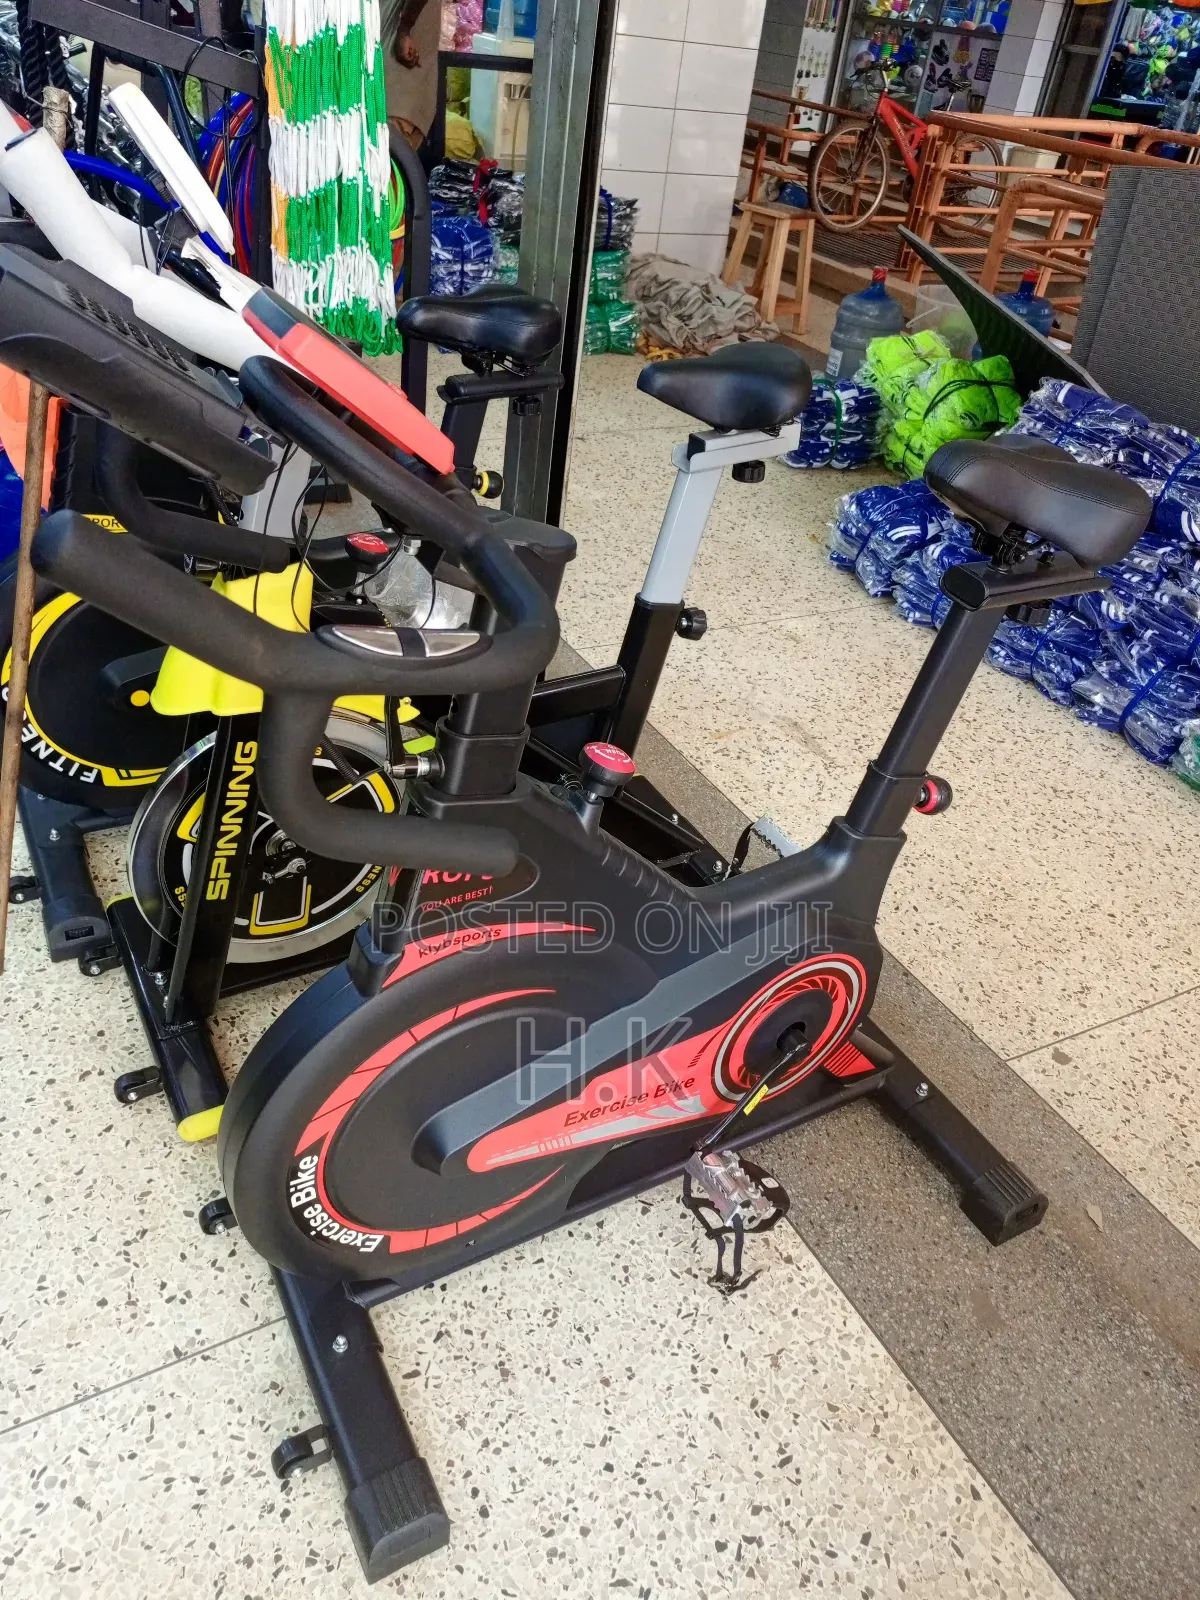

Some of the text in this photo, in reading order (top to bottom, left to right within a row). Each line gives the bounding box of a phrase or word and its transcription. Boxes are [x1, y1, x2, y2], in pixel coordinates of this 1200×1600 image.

[205, 740, 259, 901] SPINNING
[421, 899, 442, 912] YOU
[443, 895, 463, 907] ARE
[563, 1075, 696, 1128] Exercise Bike
[289, 1154, 385, 1253] Exercise Bike
